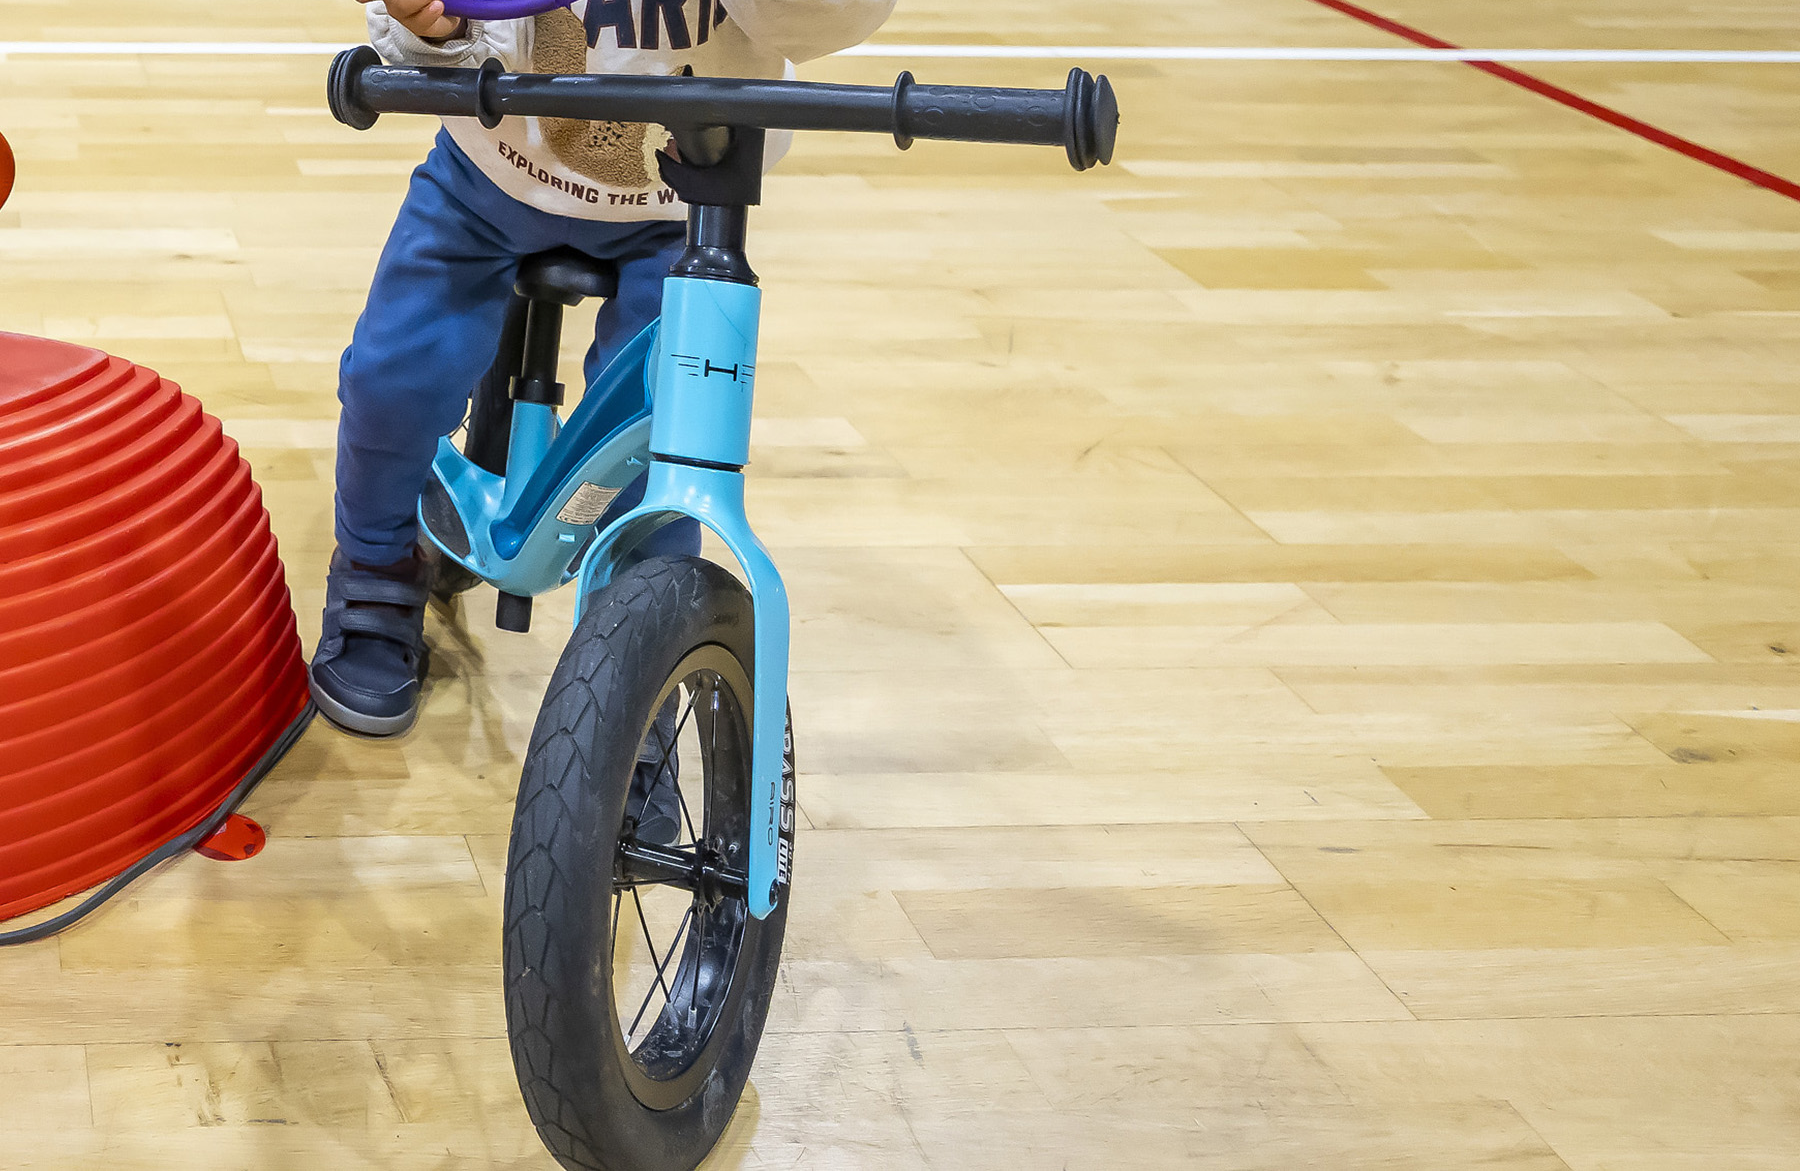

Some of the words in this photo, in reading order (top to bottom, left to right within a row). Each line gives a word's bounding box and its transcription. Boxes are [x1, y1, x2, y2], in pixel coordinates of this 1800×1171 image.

[498, 140, 599, 204] EXPLORING
[607, 192, 649, 206] THE
[779, 841, 788, 881] LITE
